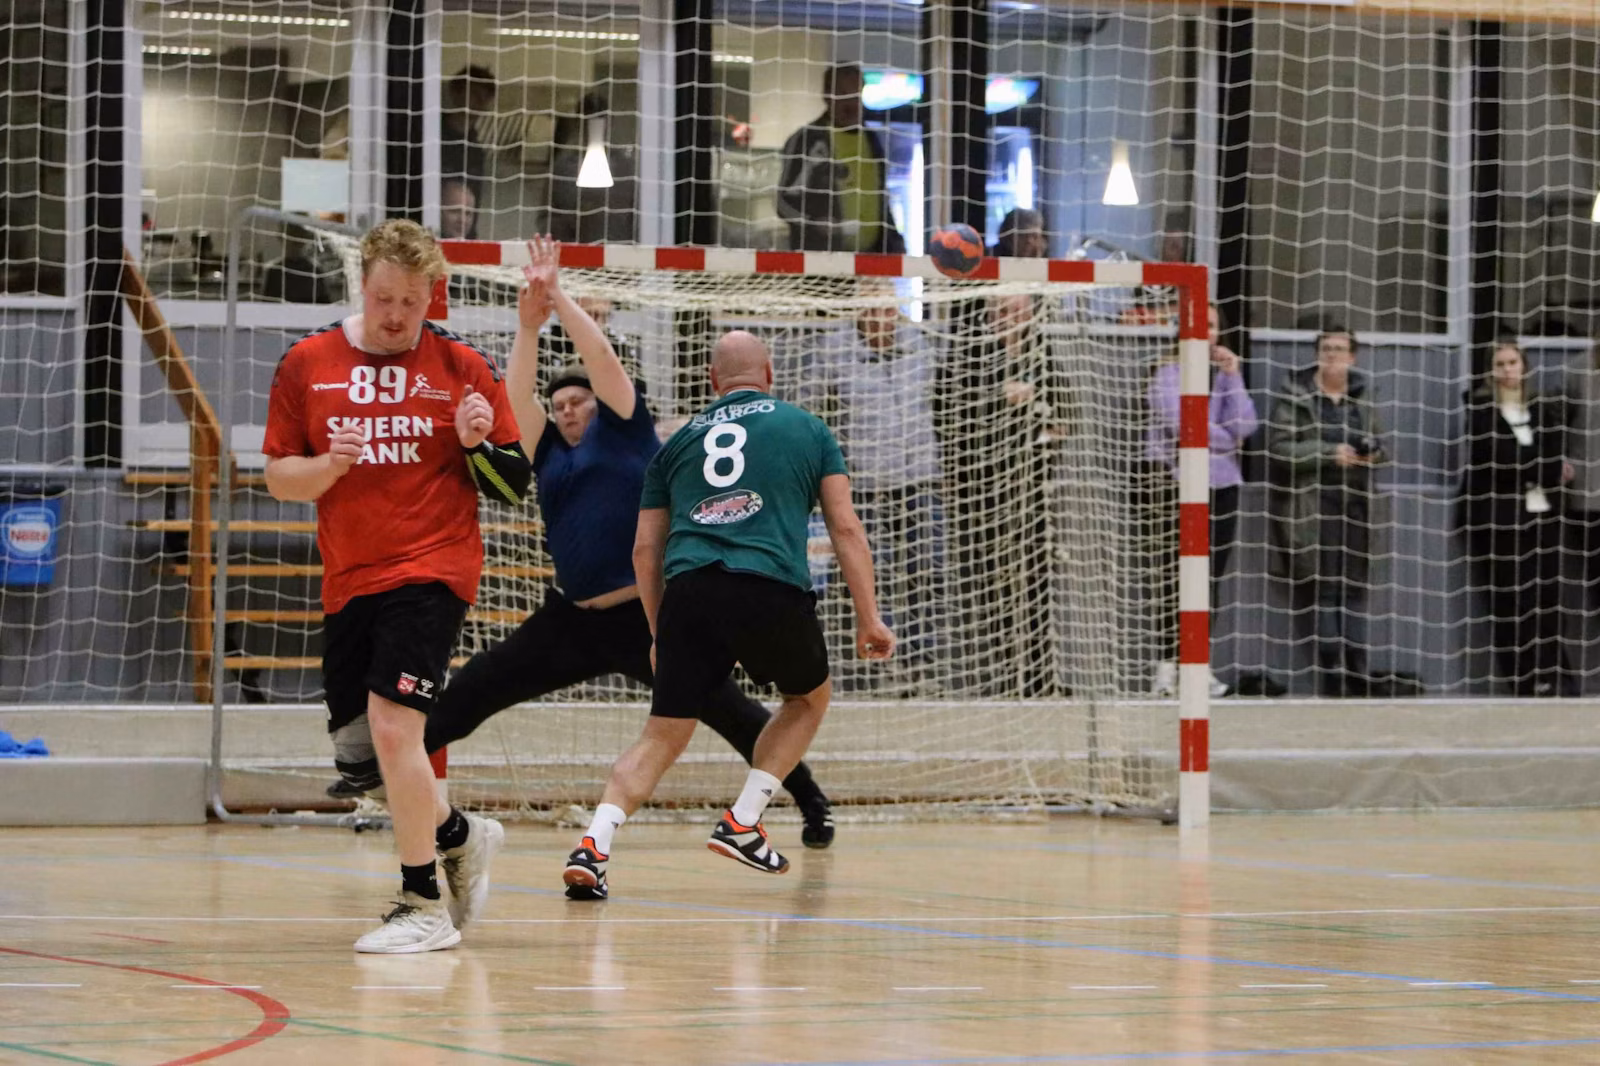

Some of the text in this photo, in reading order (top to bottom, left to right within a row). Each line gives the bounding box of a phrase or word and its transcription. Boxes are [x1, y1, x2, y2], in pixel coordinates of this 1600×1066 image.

[348, 366, 407, 404] 89
[356, 442, 422, 464] ANK
[703, 423, 747, 488] 8
